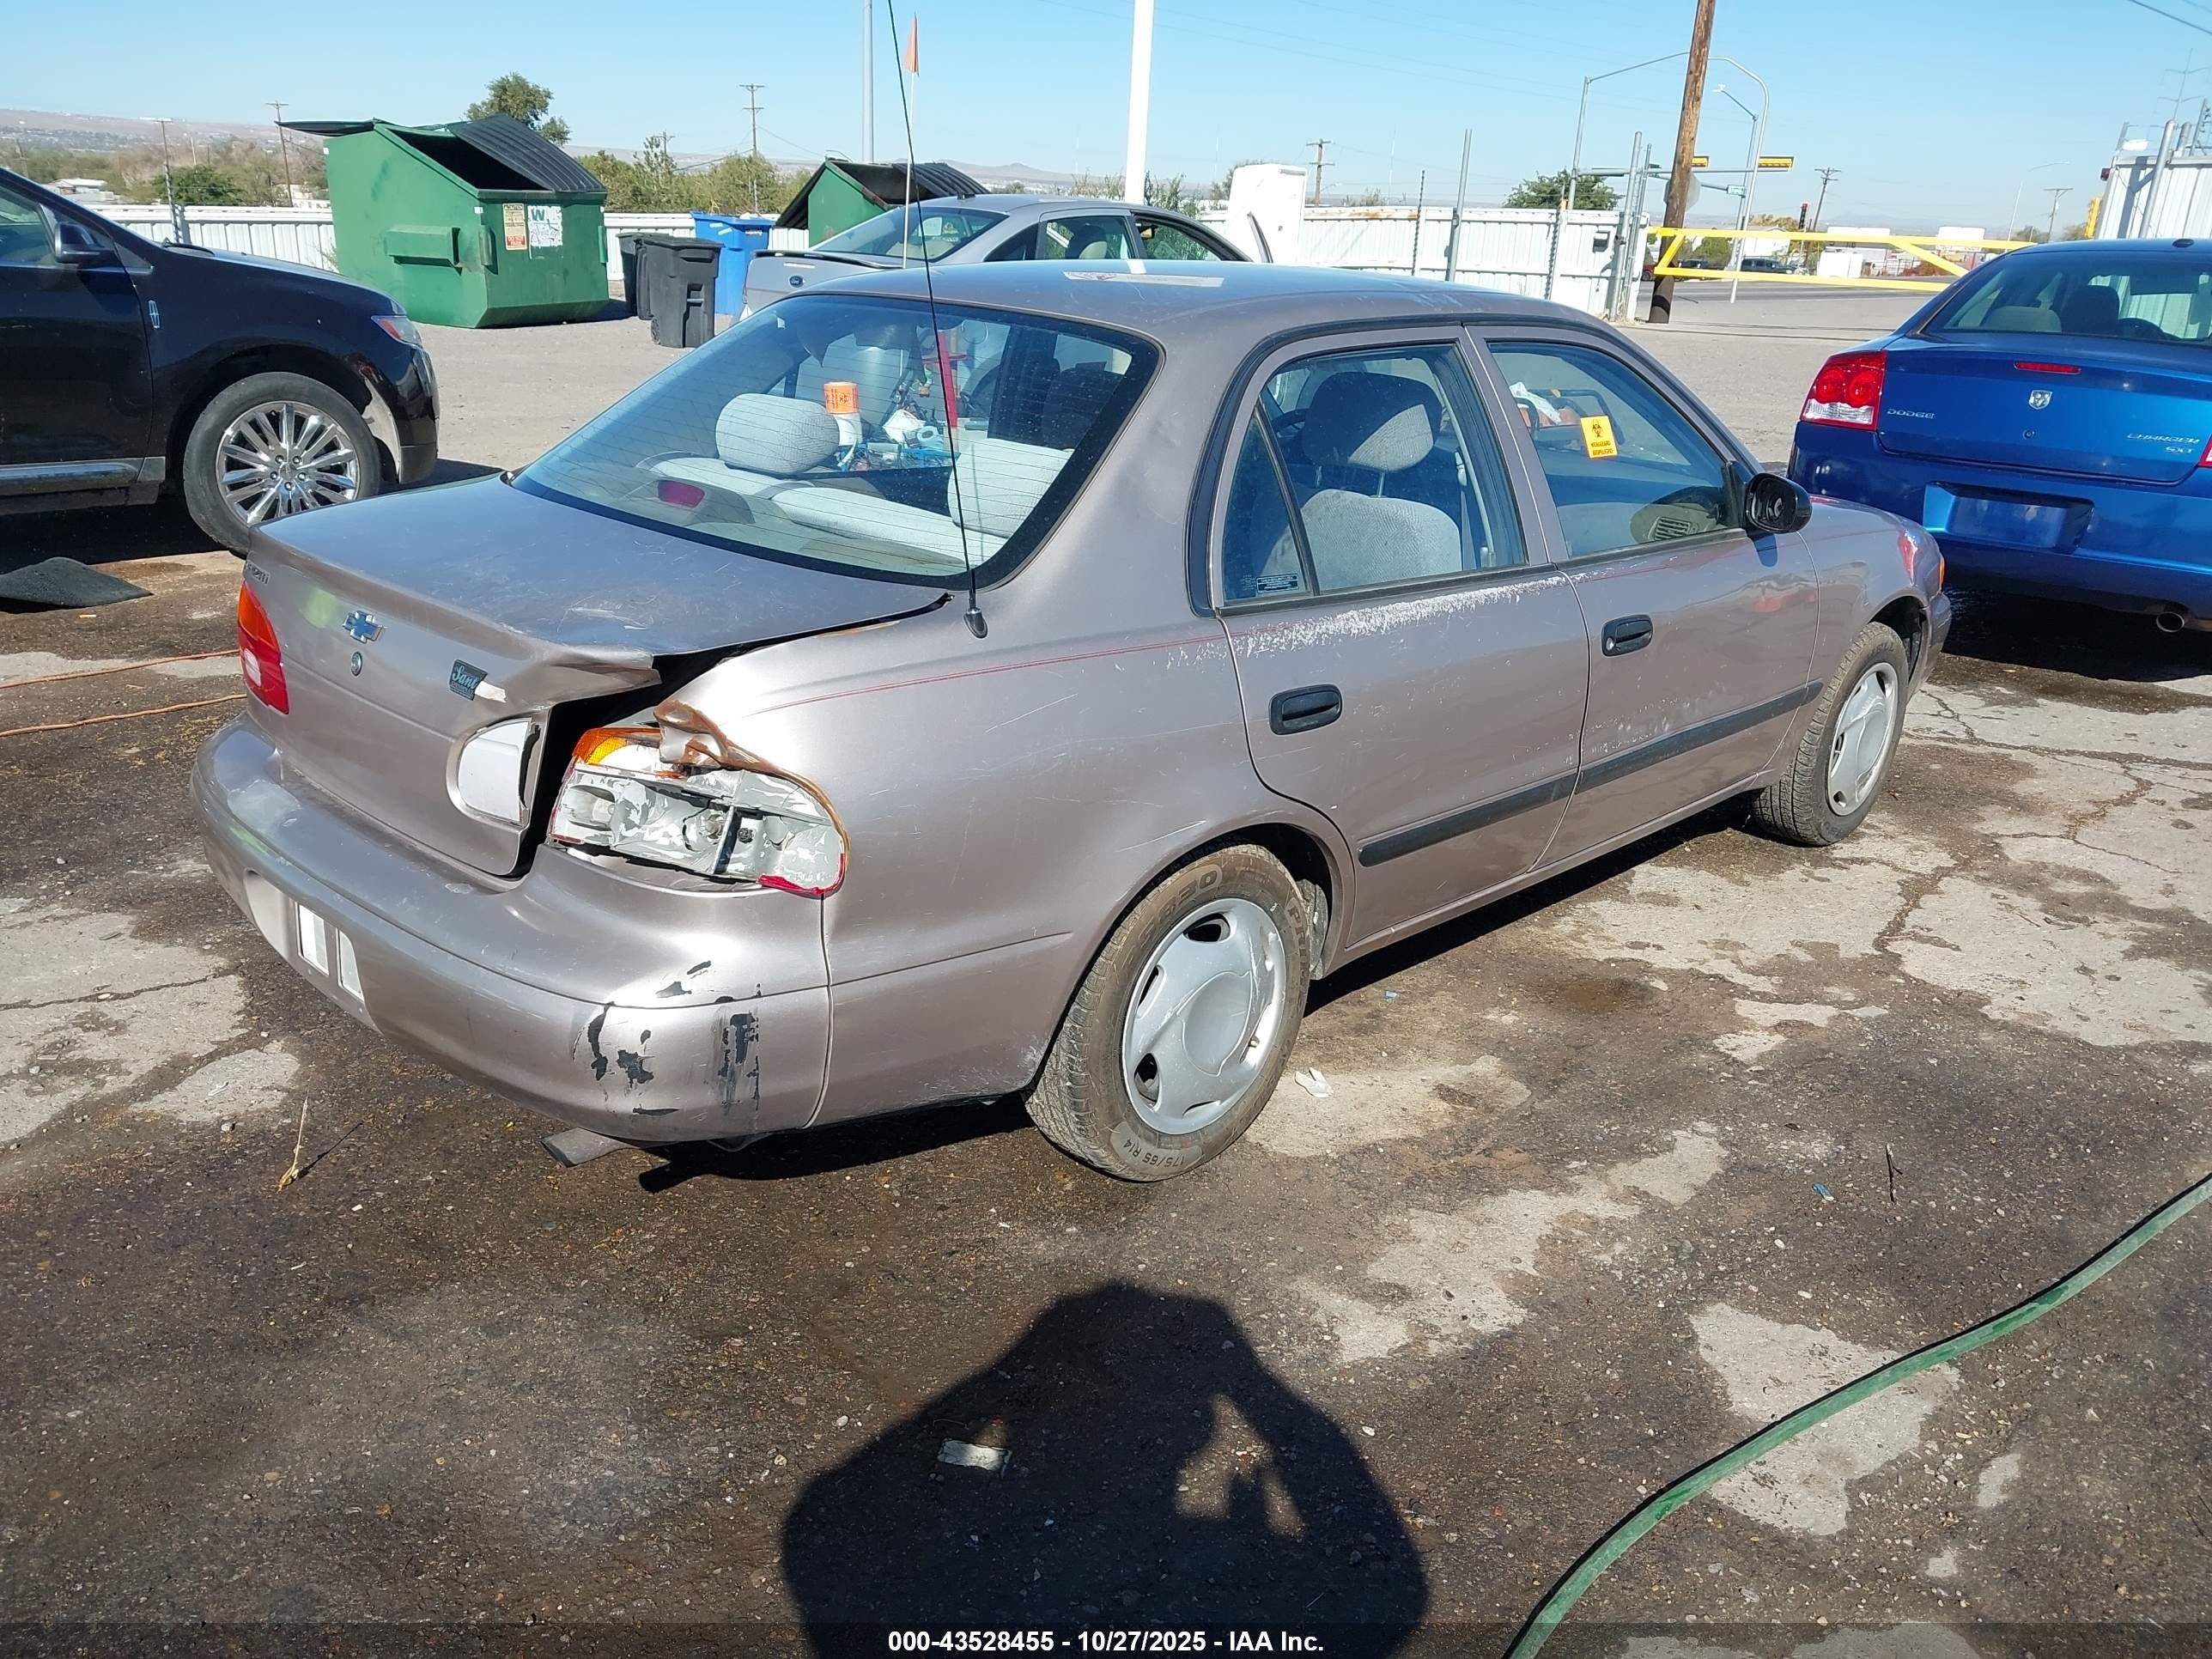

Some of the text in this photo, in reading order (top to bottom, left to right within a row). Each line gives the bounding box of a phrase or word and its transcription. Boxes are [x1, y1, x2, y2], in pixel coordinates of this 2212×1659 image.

[1887, 408, 1935, 419] DODGE
[2126, 433, 2201, 444] CHARGER
[1141, 1152, 1185, 1168] 175/65
